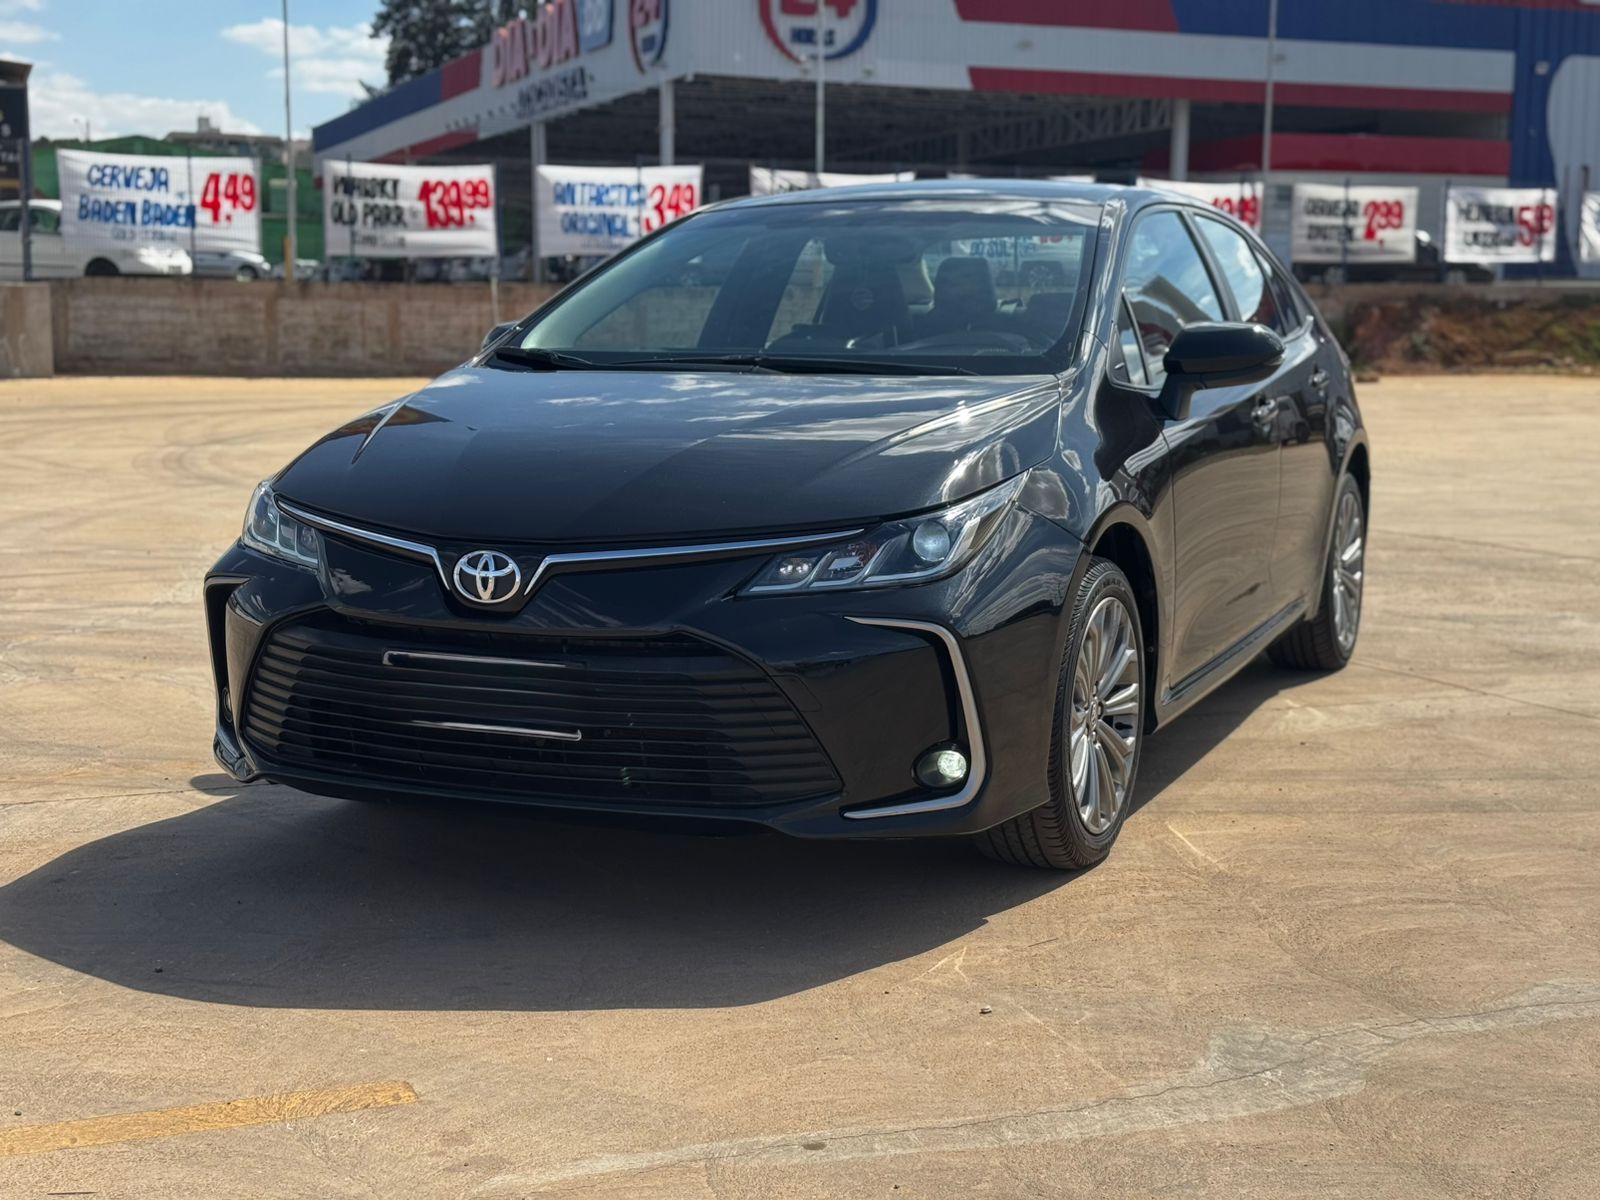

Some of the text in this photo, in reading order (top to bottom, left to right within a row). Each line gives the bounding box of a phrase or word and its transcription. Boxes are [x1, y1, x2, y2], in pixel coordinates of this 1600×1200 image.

[87, 164, 169, 192] CERVEJA
[78, 194, 196, 229] BADEN BADEN
